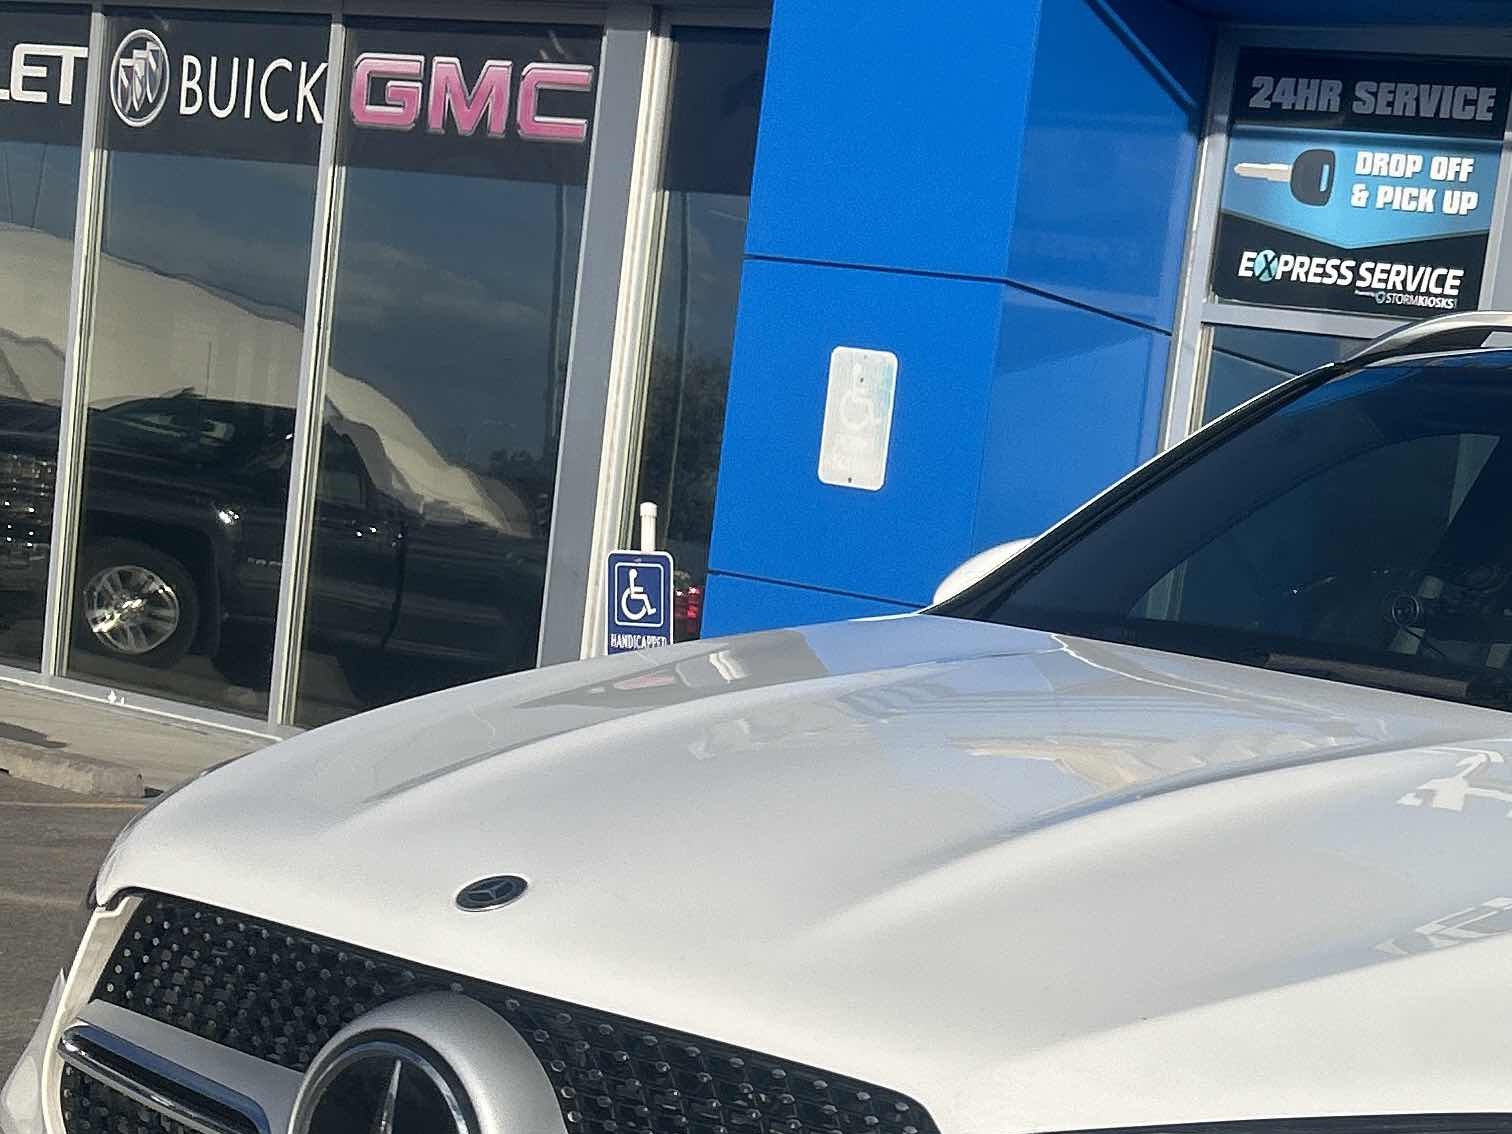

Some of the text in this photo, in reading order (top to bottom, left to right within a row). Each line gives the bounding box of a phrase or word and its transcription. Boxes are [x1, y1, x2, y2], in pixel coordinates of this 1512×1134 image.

[179, 54, 329, 123] BUICK
[351, 52, 594, 143] GMC
[1249, 75, 1497, 121] 24HR SERVICE
[1355, 151, 1475, 182] DROP OFF
[1351, 184, 1479, 216] & PICK UP
[1238, 250, 1465, 296] EXPRESS SERVICE
